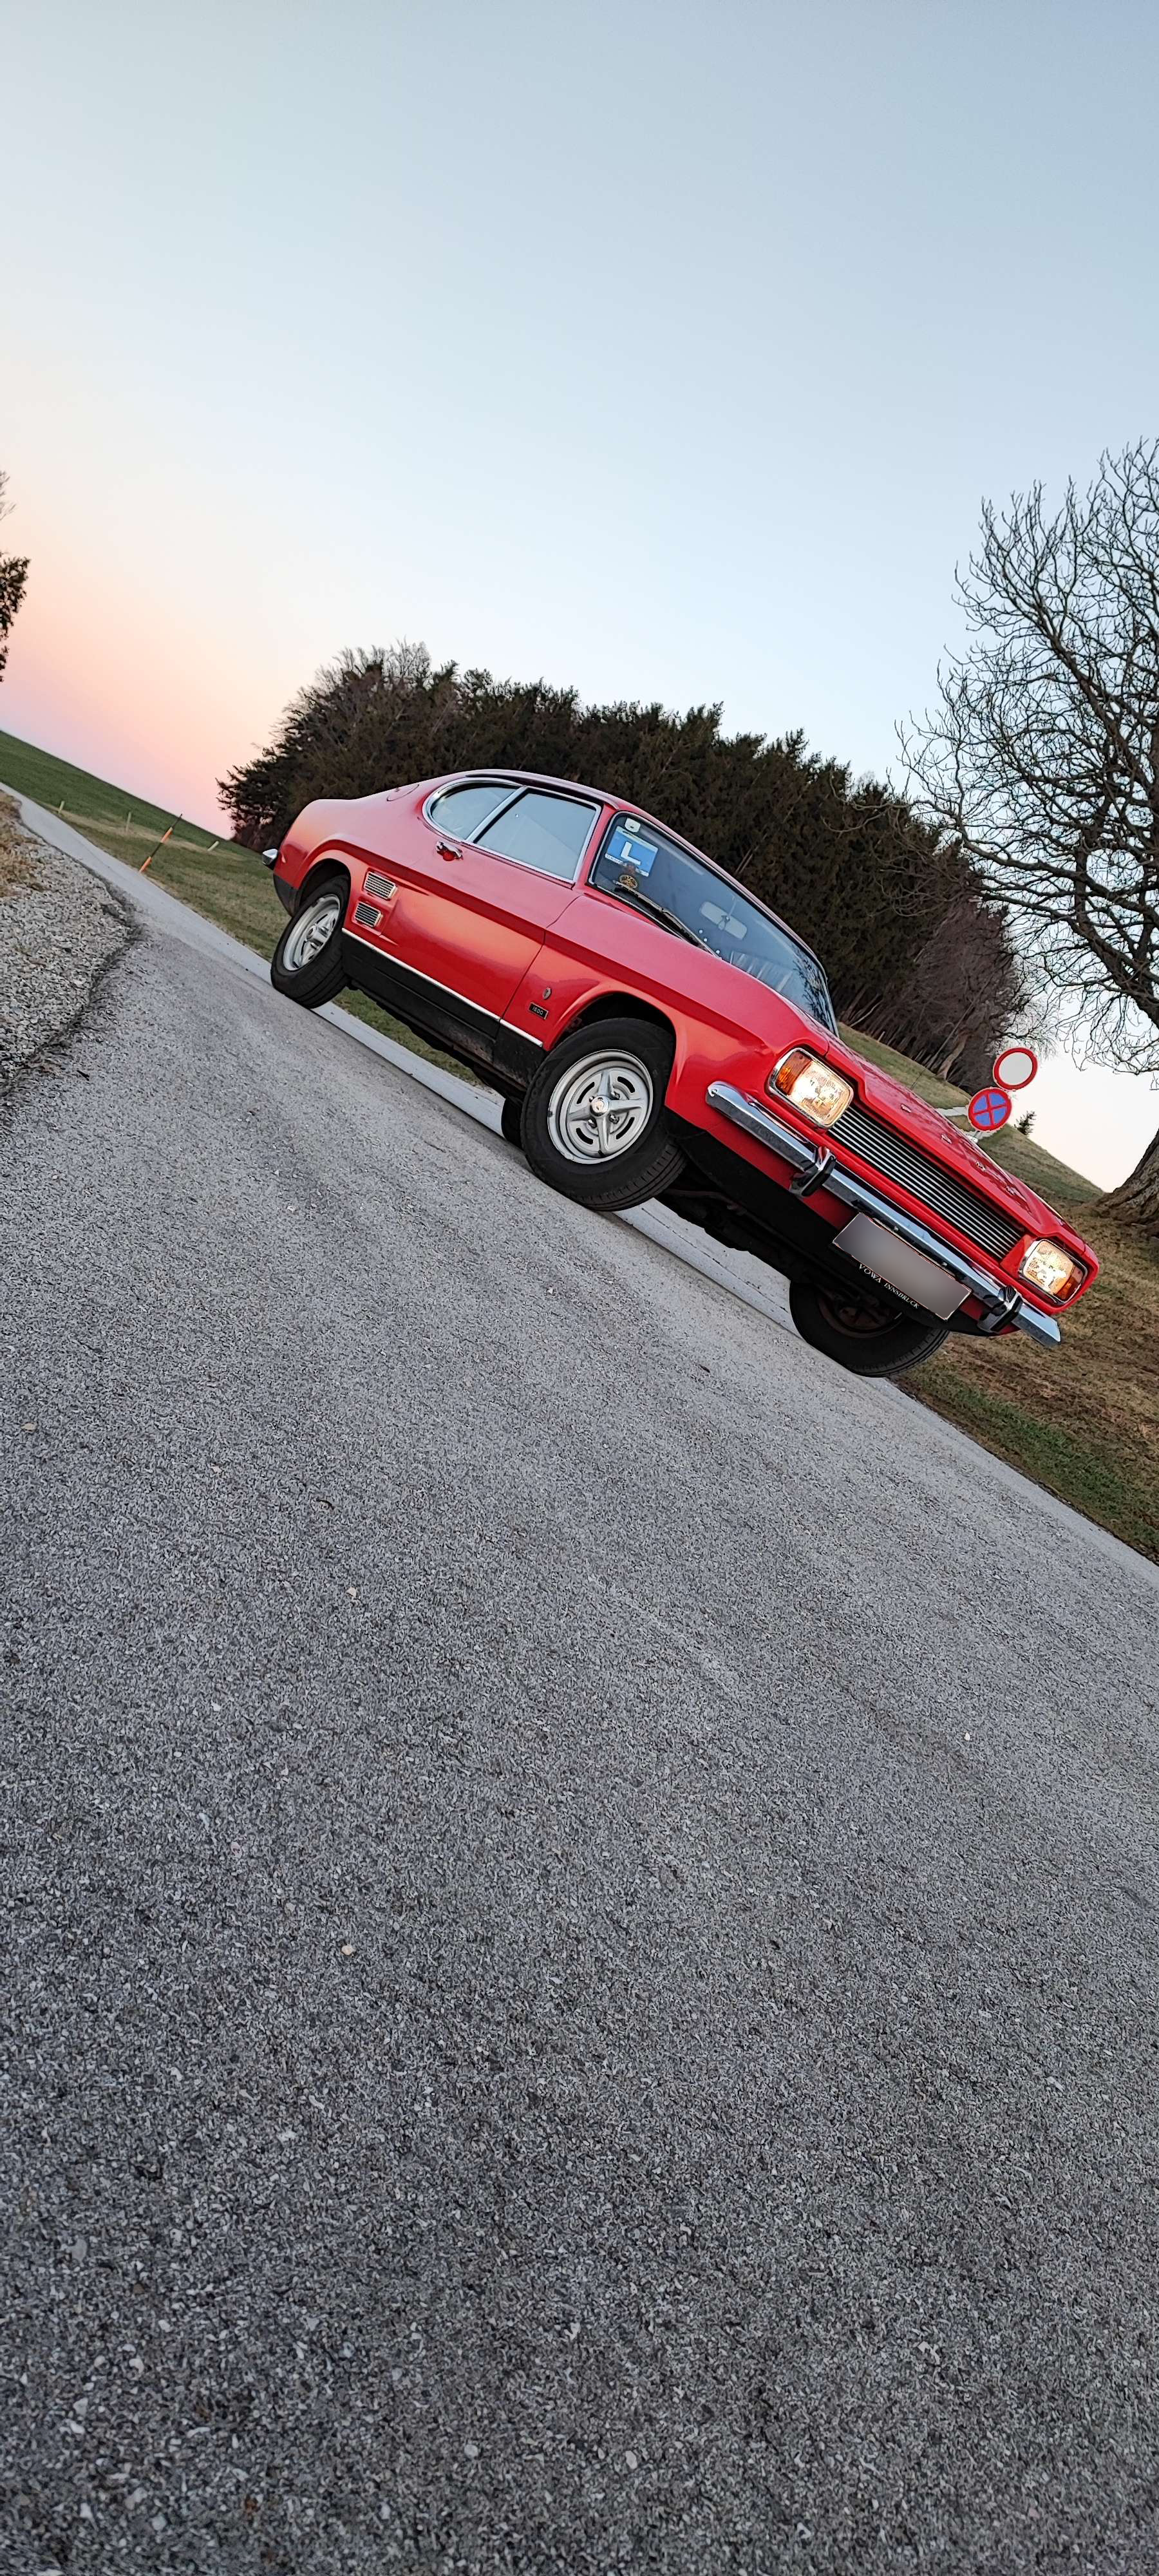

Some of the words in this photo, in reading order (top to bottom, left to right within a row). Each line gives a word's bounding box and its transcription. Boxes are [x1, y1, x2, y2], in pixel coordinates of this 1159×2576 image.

[621, 842, 641, 866] L
[859, 1264, 881, 1283] VOWA
[884, 1283, 919, 1309] INNSBRUCK
